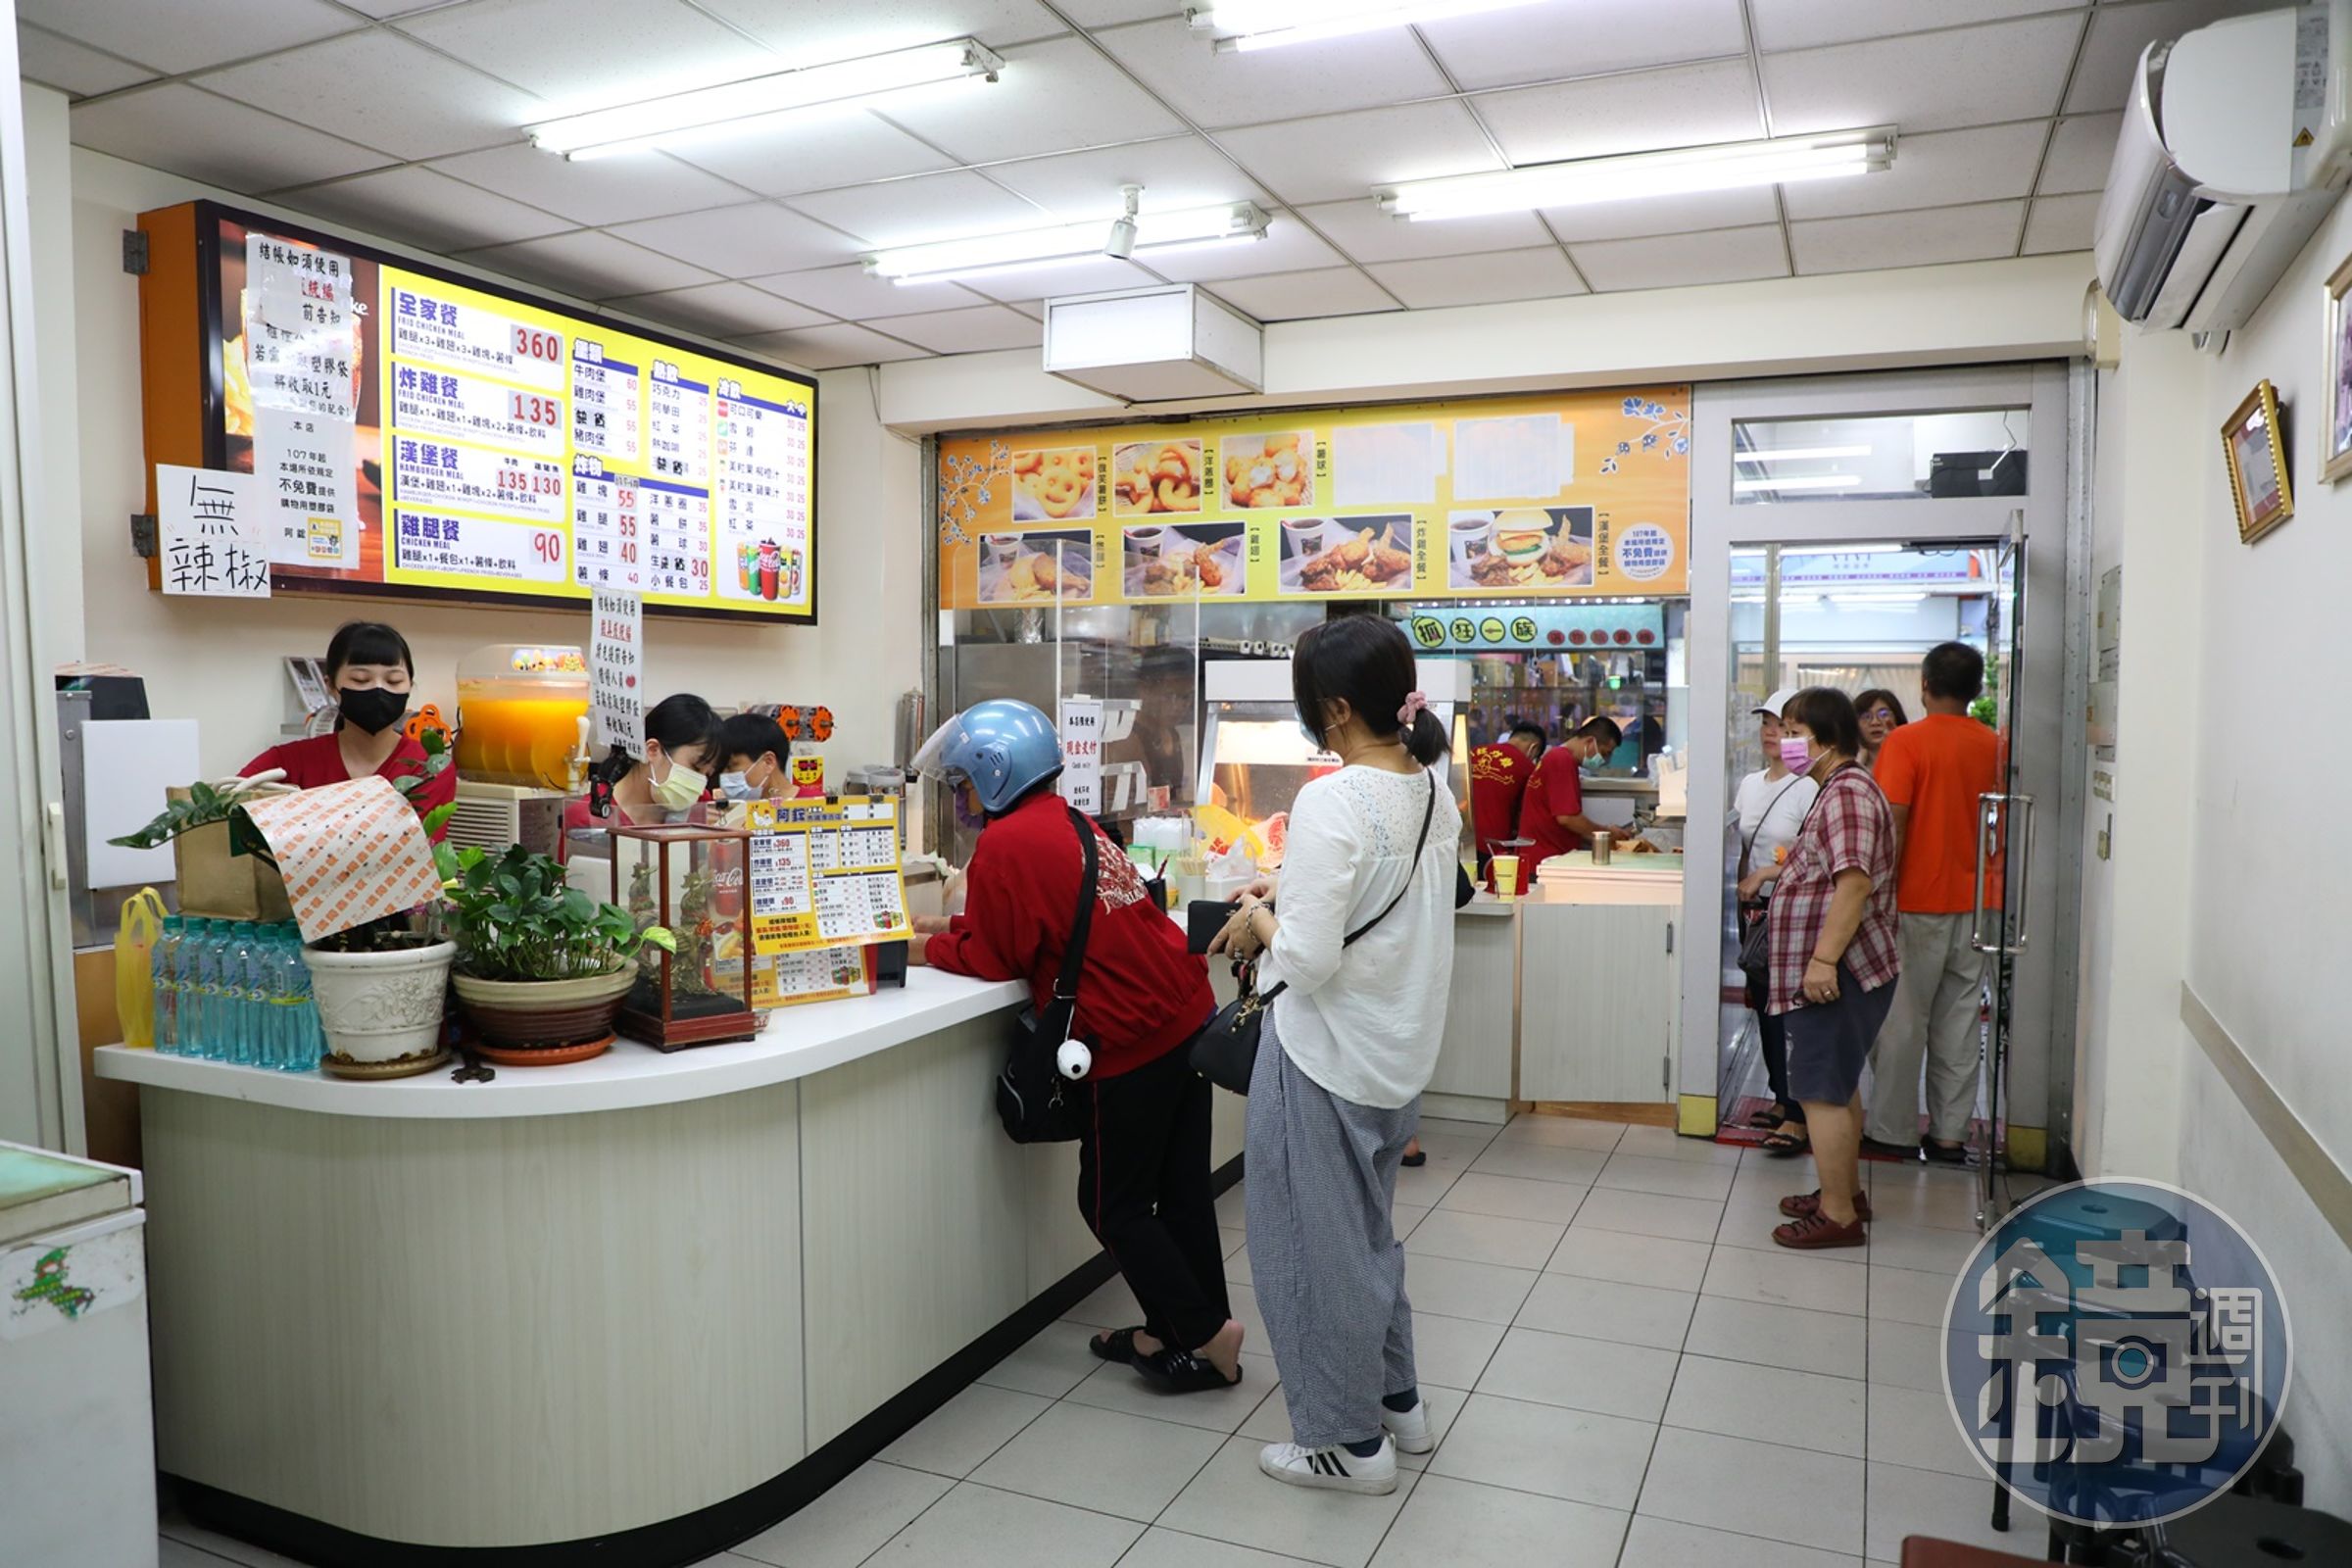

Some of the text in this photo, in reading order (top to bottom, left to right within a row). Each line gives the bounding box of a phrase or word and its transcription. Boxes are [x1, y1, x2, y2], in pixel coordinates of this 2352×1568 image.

[259, 242, 339, 277] 結帳如須使用
[399, 292, 458, 327] 全家餐
[416, 319, 446, 335] CHICKEN
[516, 328, 558, 362] 360
[399, 367, 458, 399] 炸雞餐
[514, 394, 557, 425] 135
[400, 440, 458, 470] 漢堡餐
[400, 463, 444, 477] HAMBURGER
[498, 469, 527, 491] 135
[278, 477, 337, 498] 不免費提供
[533, 475, 562, 496] 130
[190, 474, 238, 535] 無
[618, 489, 635, 508] 55
[401, 514, 460, 542] 雞腿餐
[620, 514, 636, 537] 55
[401, 536, 451, 550] CHICKEN MEAL
[534, 532, 560, 564] 90
[621, 541, 636, 564] 40
[169, 541, 268, 591] 辣椒
[691, 559, 709, 577] 30
[1066, 740, 1097, 755] 現金支付
